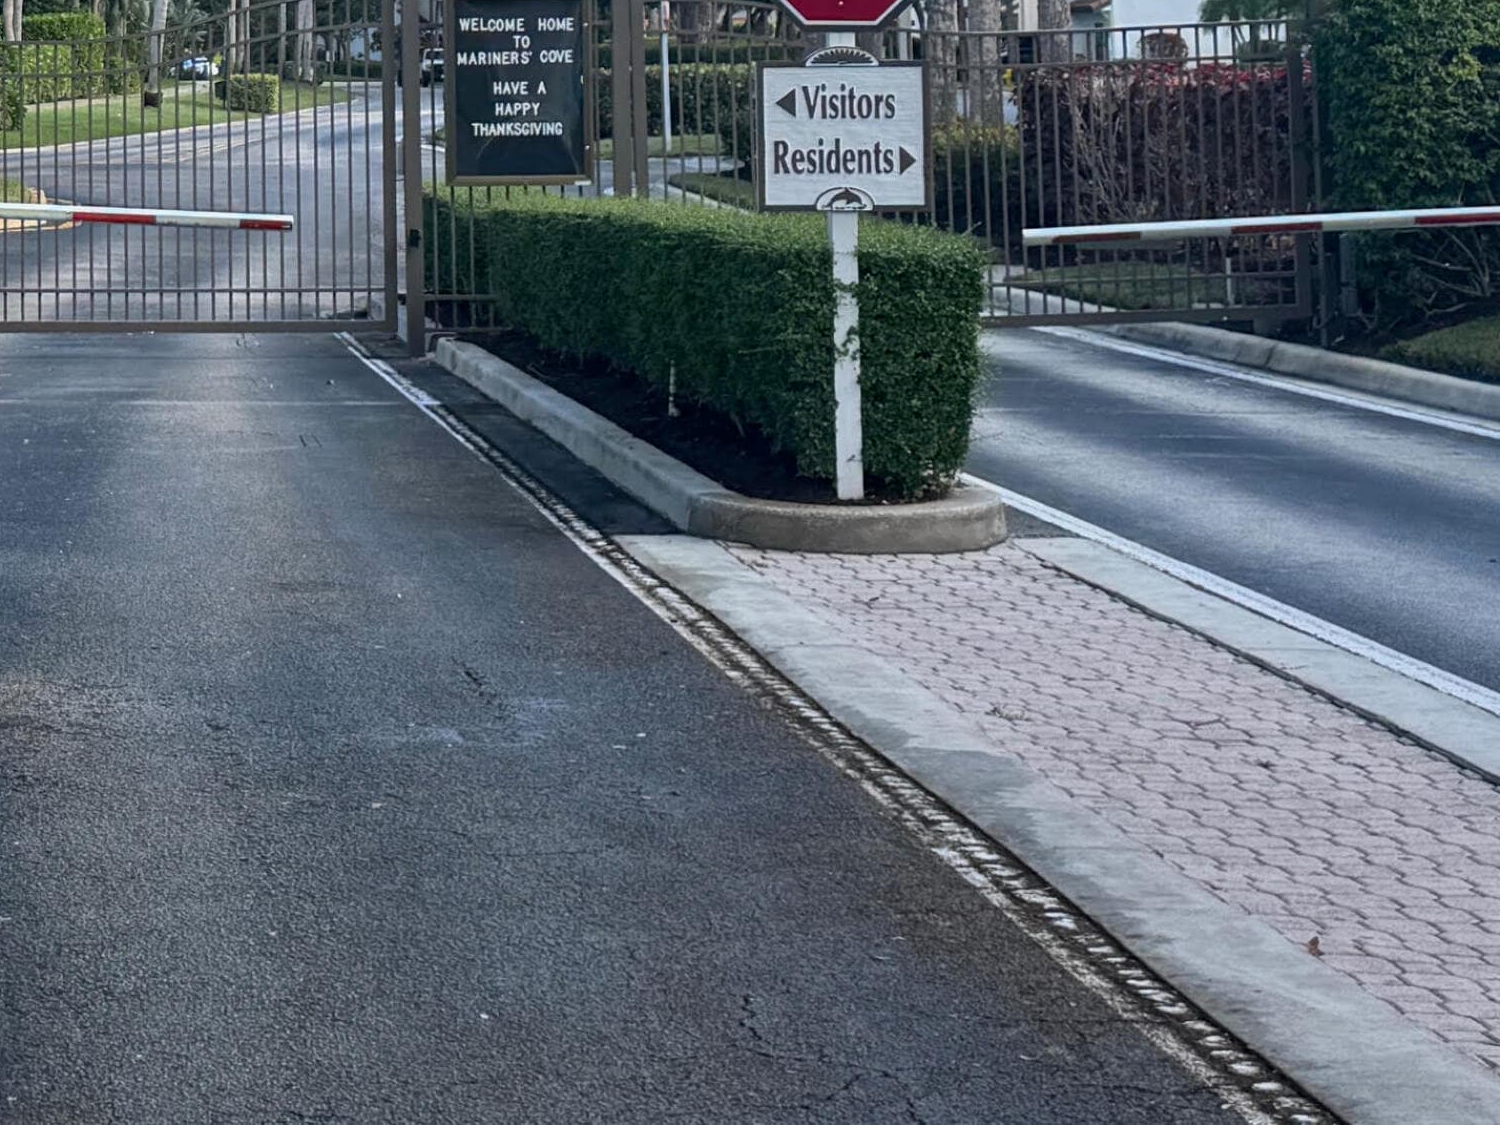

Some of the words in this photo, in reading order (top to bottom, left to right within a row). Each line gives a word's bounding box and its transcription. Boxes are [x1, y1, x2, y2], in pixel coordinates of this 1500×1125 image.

[459, 17, 525, 32] WELCOME
[538, 17, 575, 31] HOME
[512, 35, 531, 49] TO
[457, 51, 533, 65] MARINERS'
[539, 49, 574, 63] COVE
[493, 81, 529, 95] HAVE
[537, 81, 547, 95] A
[495, 102, 541, 116] HAPPY
[801, 83, 896, 120] Visitors
[471, 121, 563, 137] THANKSGIVING
[773, 138, 894, 175] Residents
